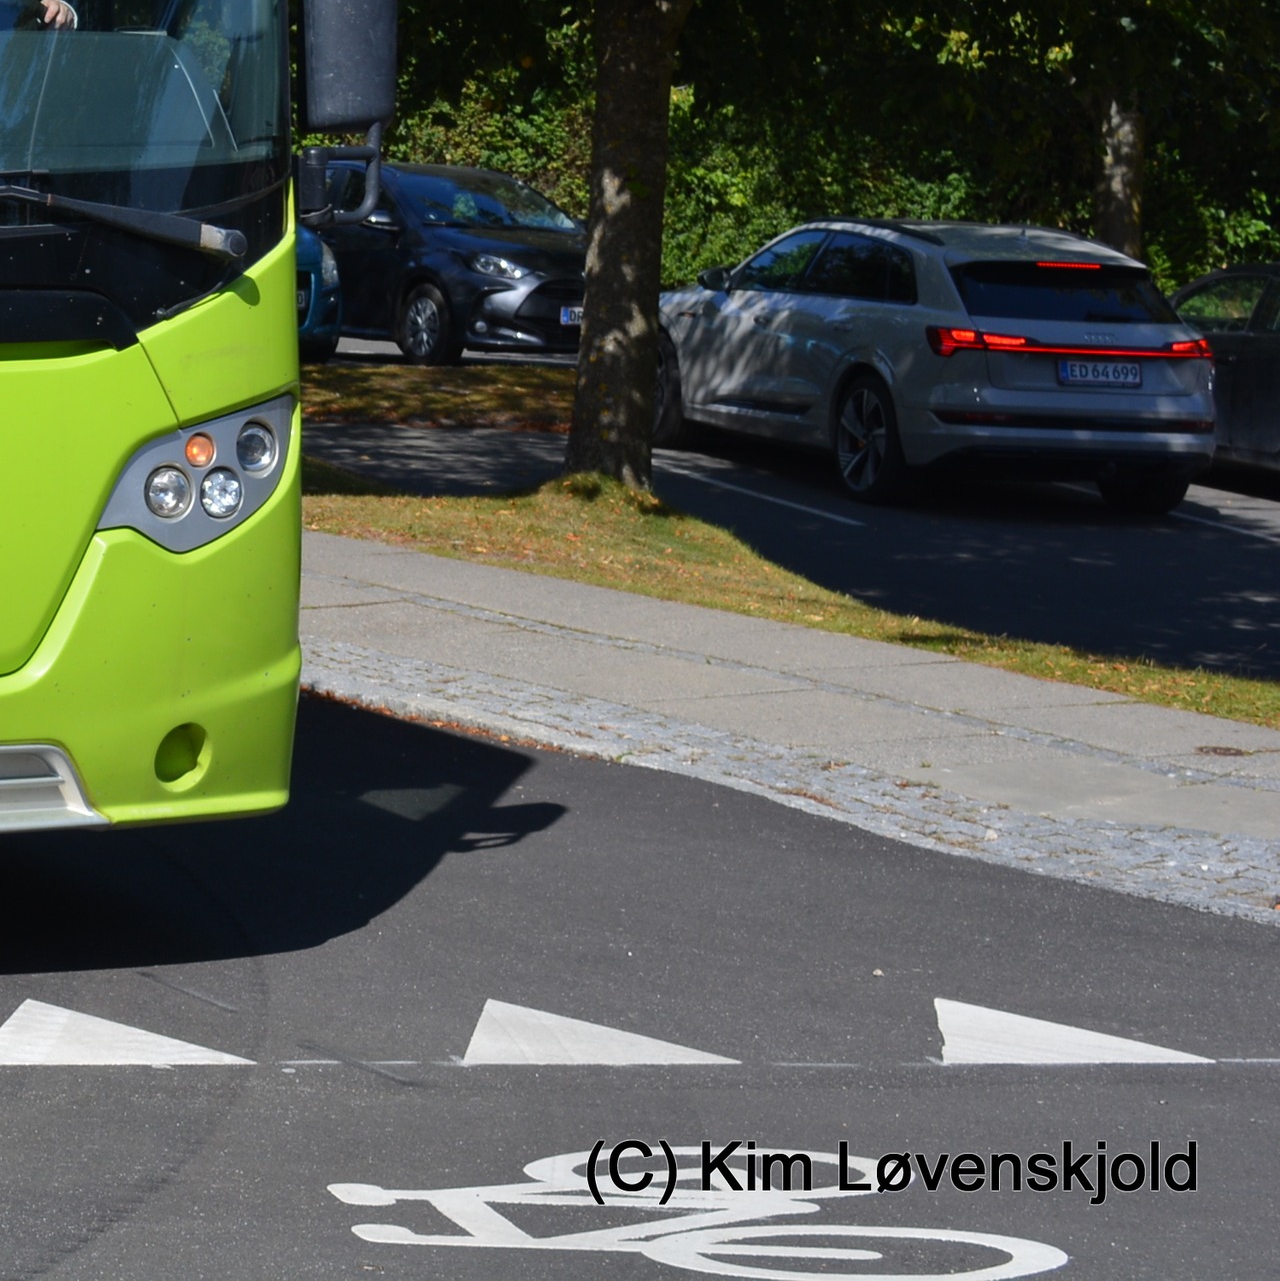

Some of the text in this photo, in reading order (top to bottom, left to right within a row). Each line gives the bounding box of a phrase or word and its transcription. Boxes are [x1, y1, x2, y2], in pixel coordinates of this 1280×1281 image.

[1070, 364, 1138, 380] ED 64 699
